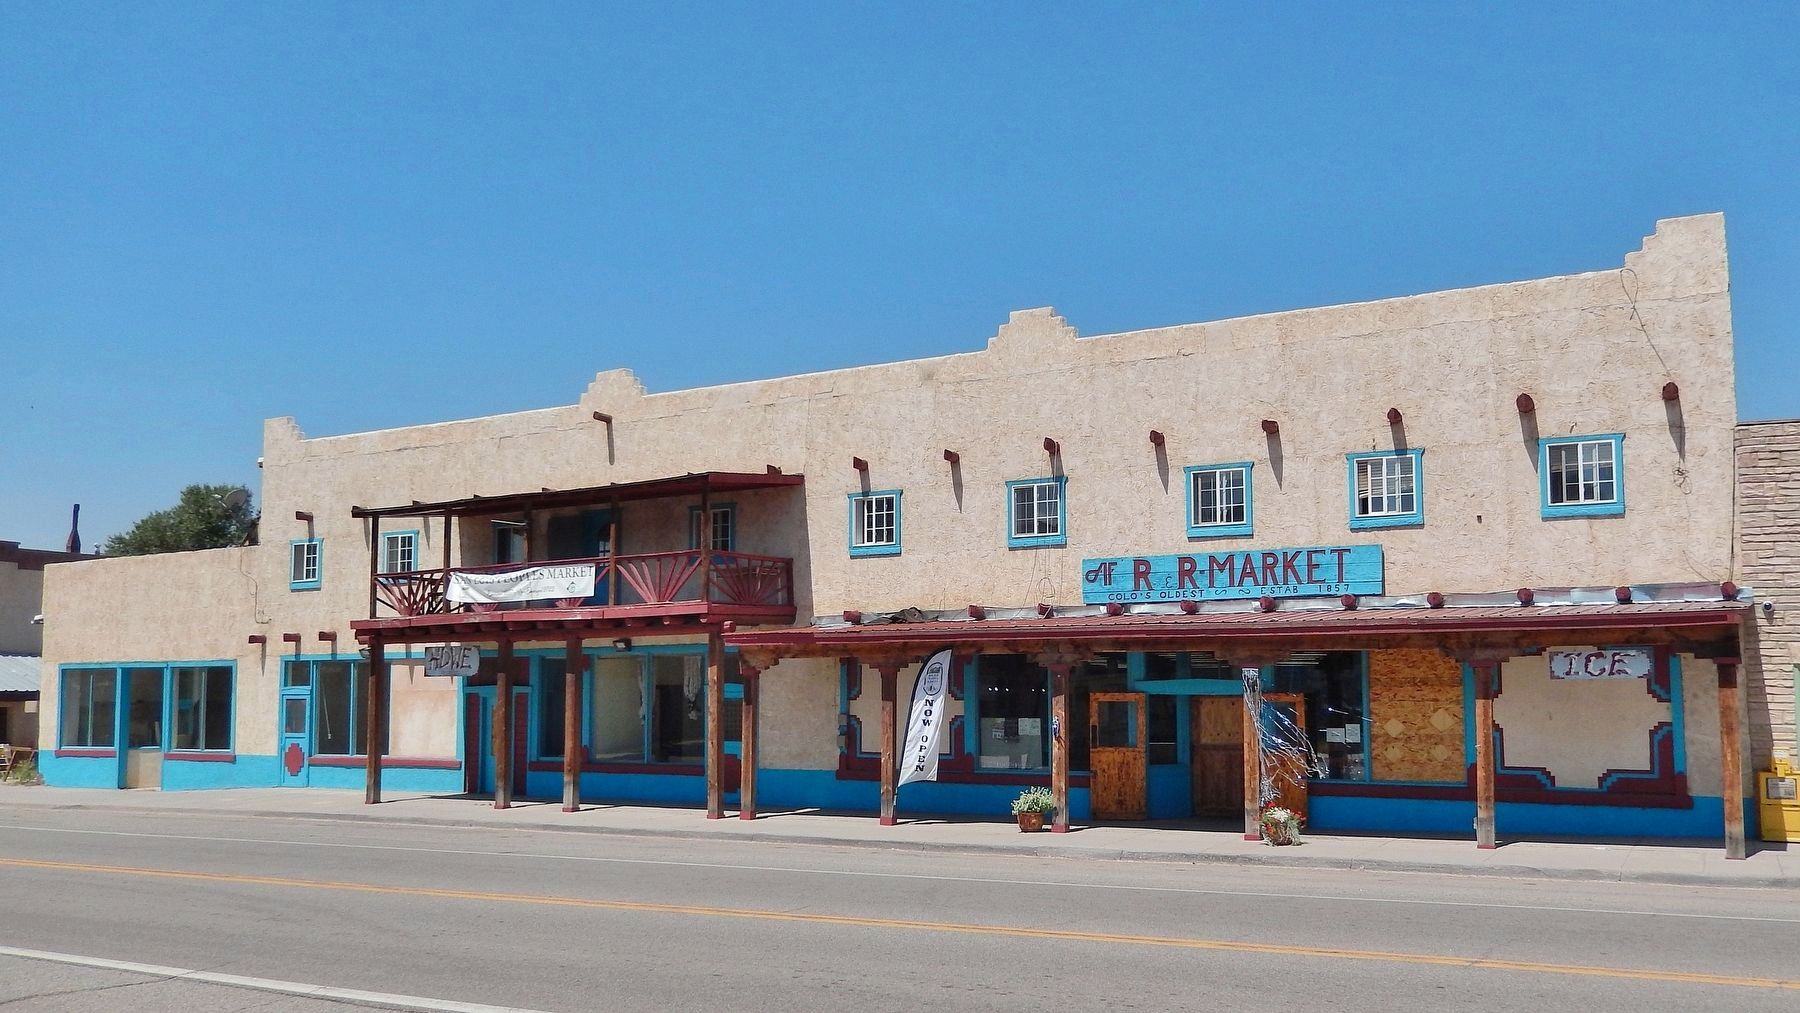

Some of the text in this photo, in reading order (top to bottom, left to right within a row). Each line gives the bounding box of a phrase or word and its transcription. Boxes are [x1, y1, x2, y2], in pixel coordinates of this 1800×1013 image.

[547, 565, 593, 580] MARKET
[1132, 559, 1155, 591] R
[1108, 583, 1350, 600] COLO'S OLDEST ESTAB 1857
[1563, 651, 1636, 677] ICE
[921, 699, 934, 727] NOW
[914, 735, 929, 772] OPEN
